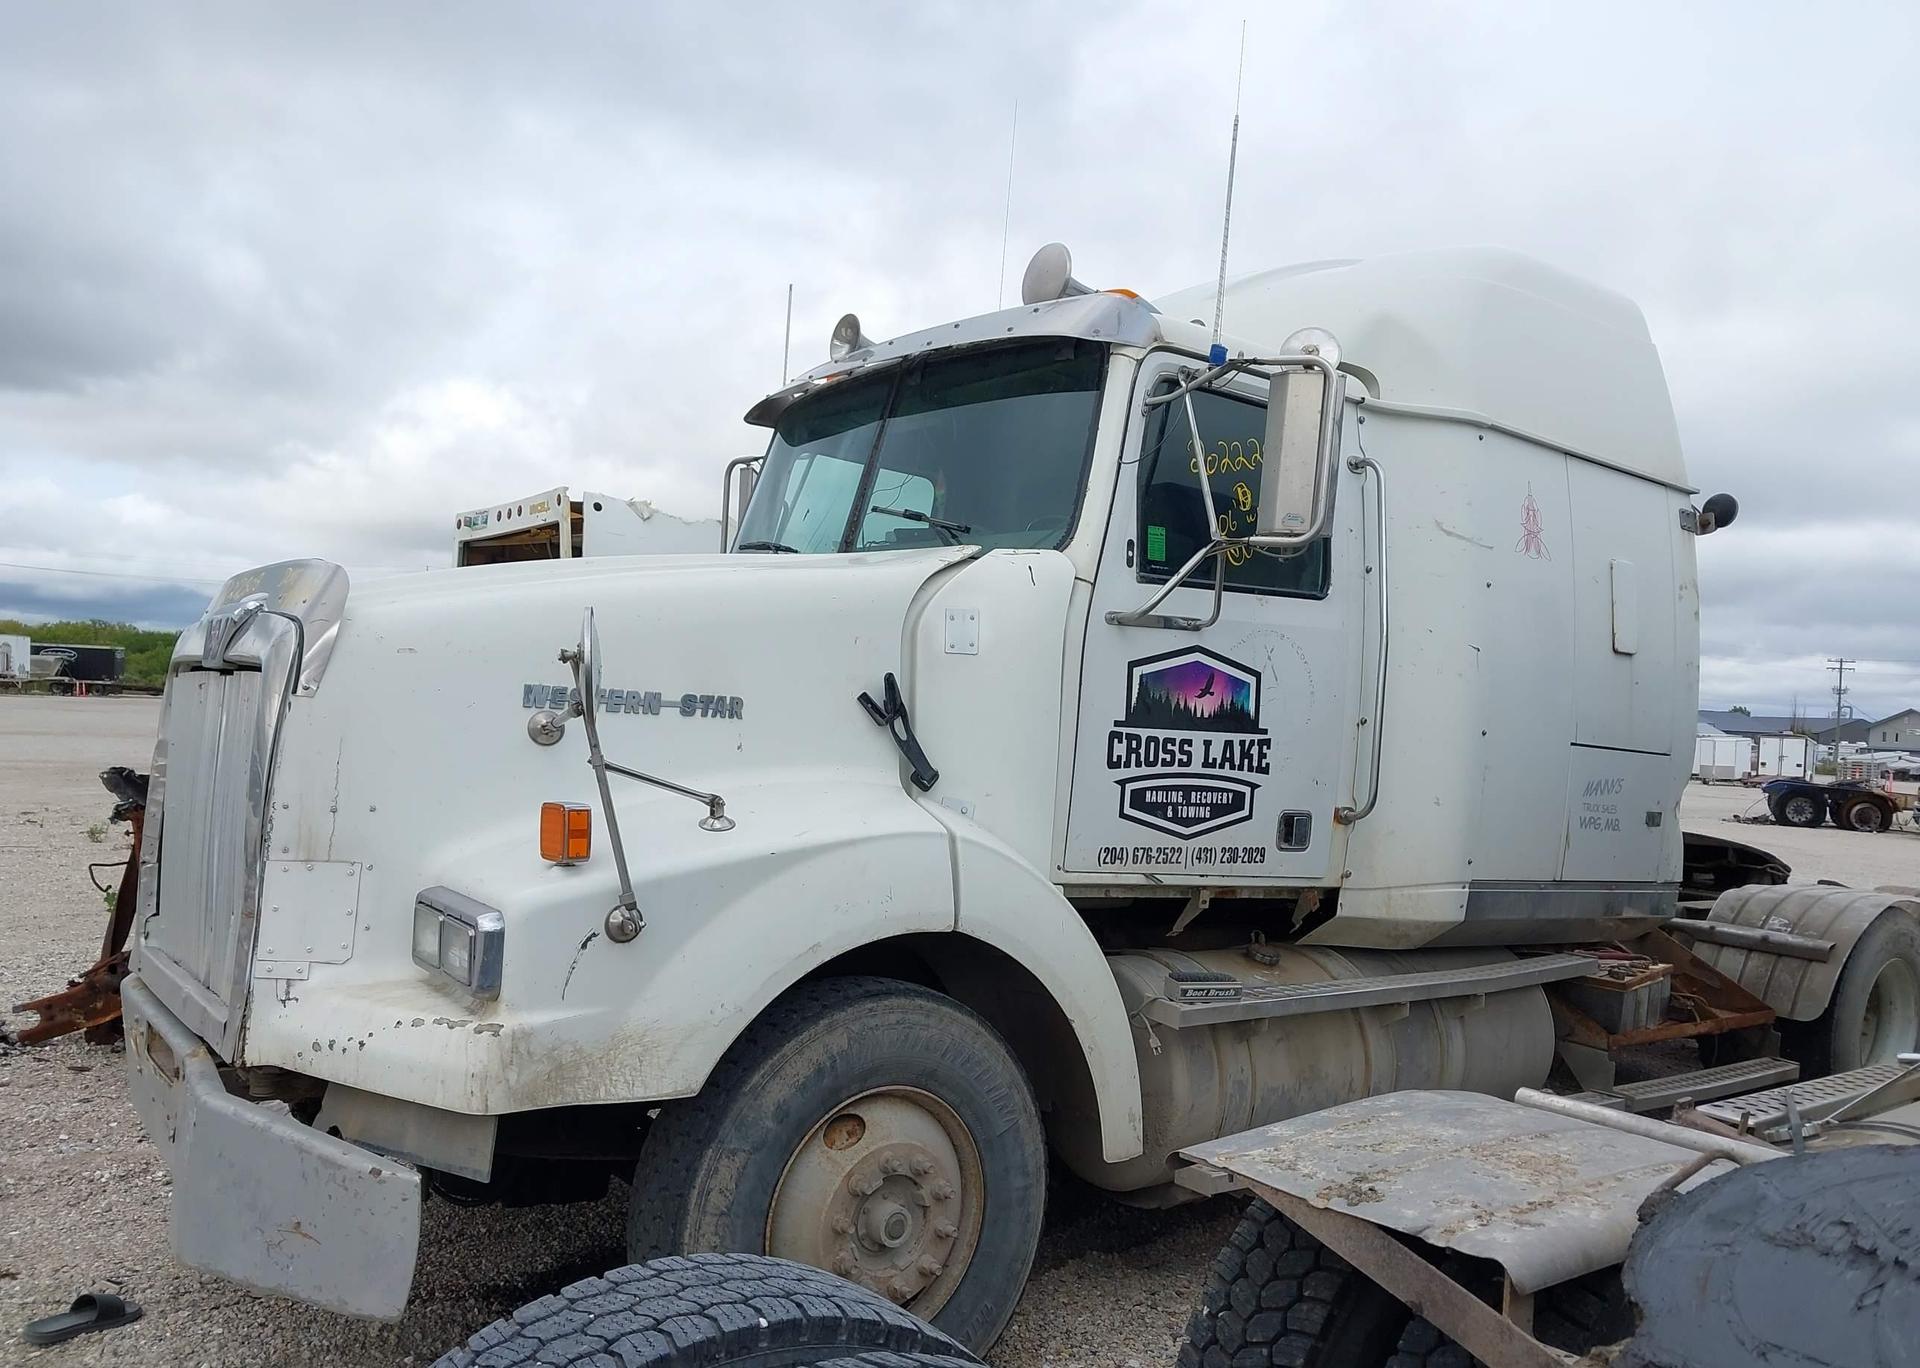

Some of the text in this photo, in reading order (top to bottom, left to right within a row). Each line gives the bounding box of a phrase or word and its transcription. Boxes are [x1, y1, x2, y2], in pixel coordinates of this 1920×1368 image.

[679, 693, 744, 720] STAR
[1106, 730, 1272, 775] CROSS LAKE
[1145, 790, 1234, 805] HAULING, RECOVERY
[1167, 805, 1211, 818] & TOWING
[1097, 846, 1129, 868] (204)
[1131, 846, 1183, 865] 676-2522
[1191, 847, 1217, 867] (431)
[1219, 847, 1266, 865] 230-2029
[1208, 988, 1236, 997] Brush
